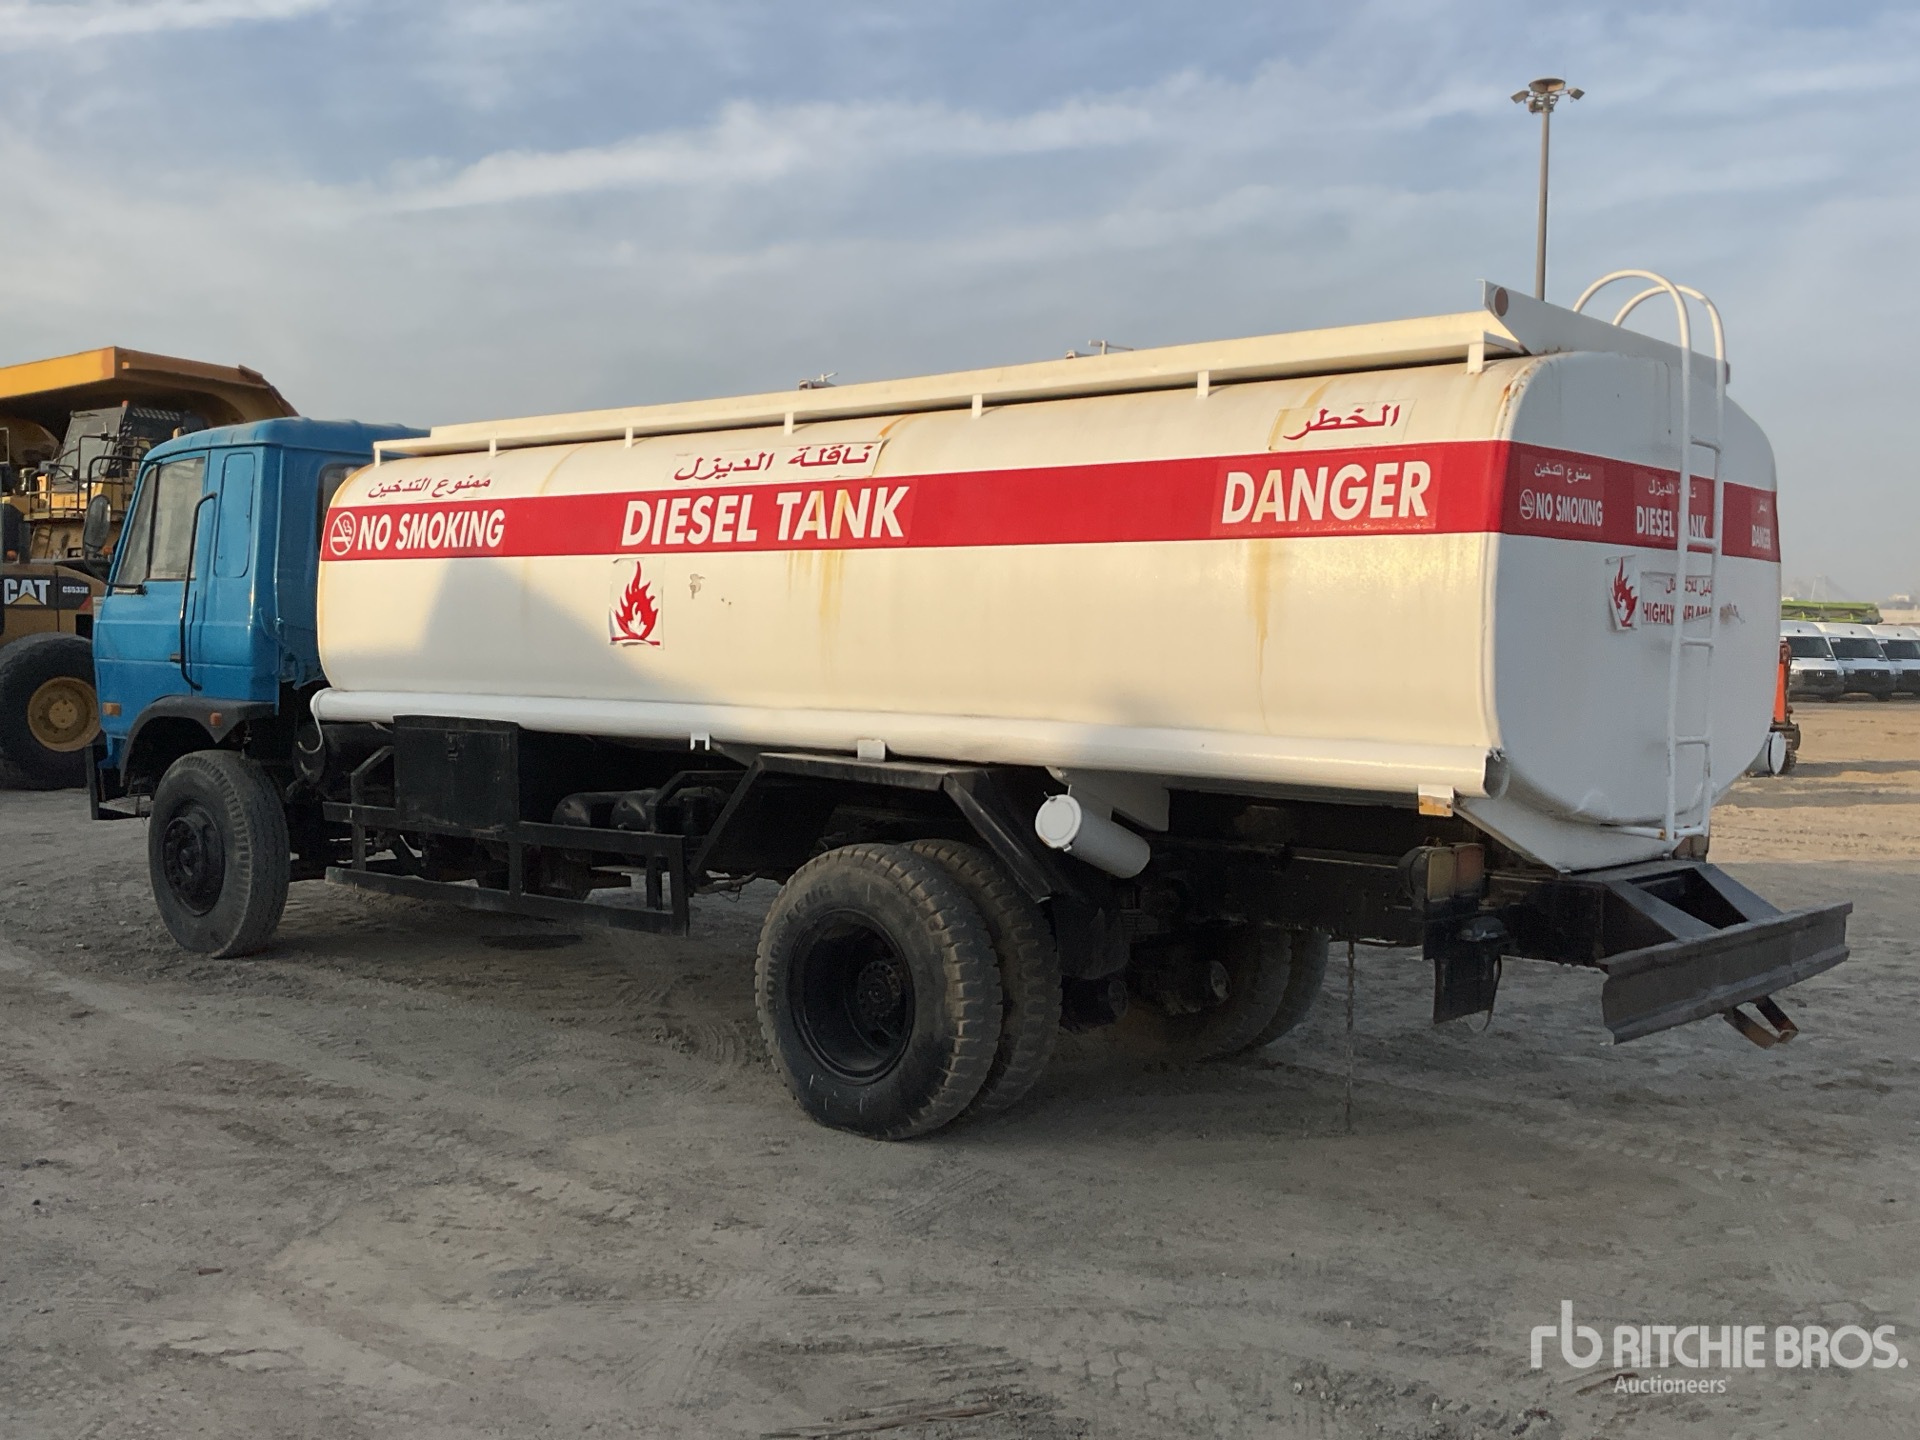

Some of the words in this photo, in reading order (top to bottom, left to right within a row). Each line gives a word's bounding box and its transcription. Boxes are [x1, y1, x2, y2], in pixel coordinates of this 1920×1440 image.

[1283, 404, 1400, 440] الخطر
[674, 452, 775, 481] الديزل
[788, 444, 874, 467] ناقلة
[368, 477, 432, 498] التدخين
[431, 474, 491, 498] ممنوع
[1222, 460, 1431, 524] DANGER
[621, 495, 757, 547] DIESEL
[776, 486, 910, 541] TANK
[1536, 492, 1553, 520] NO
[1556, 494, 1603, 527] SMOKING
[1636, 505, 1675, 538] DIESEL
[357, 514, 392, 550] NO
[395, 509, 506, 550] SMOKING
[3, 579, 51, 606] CAT
